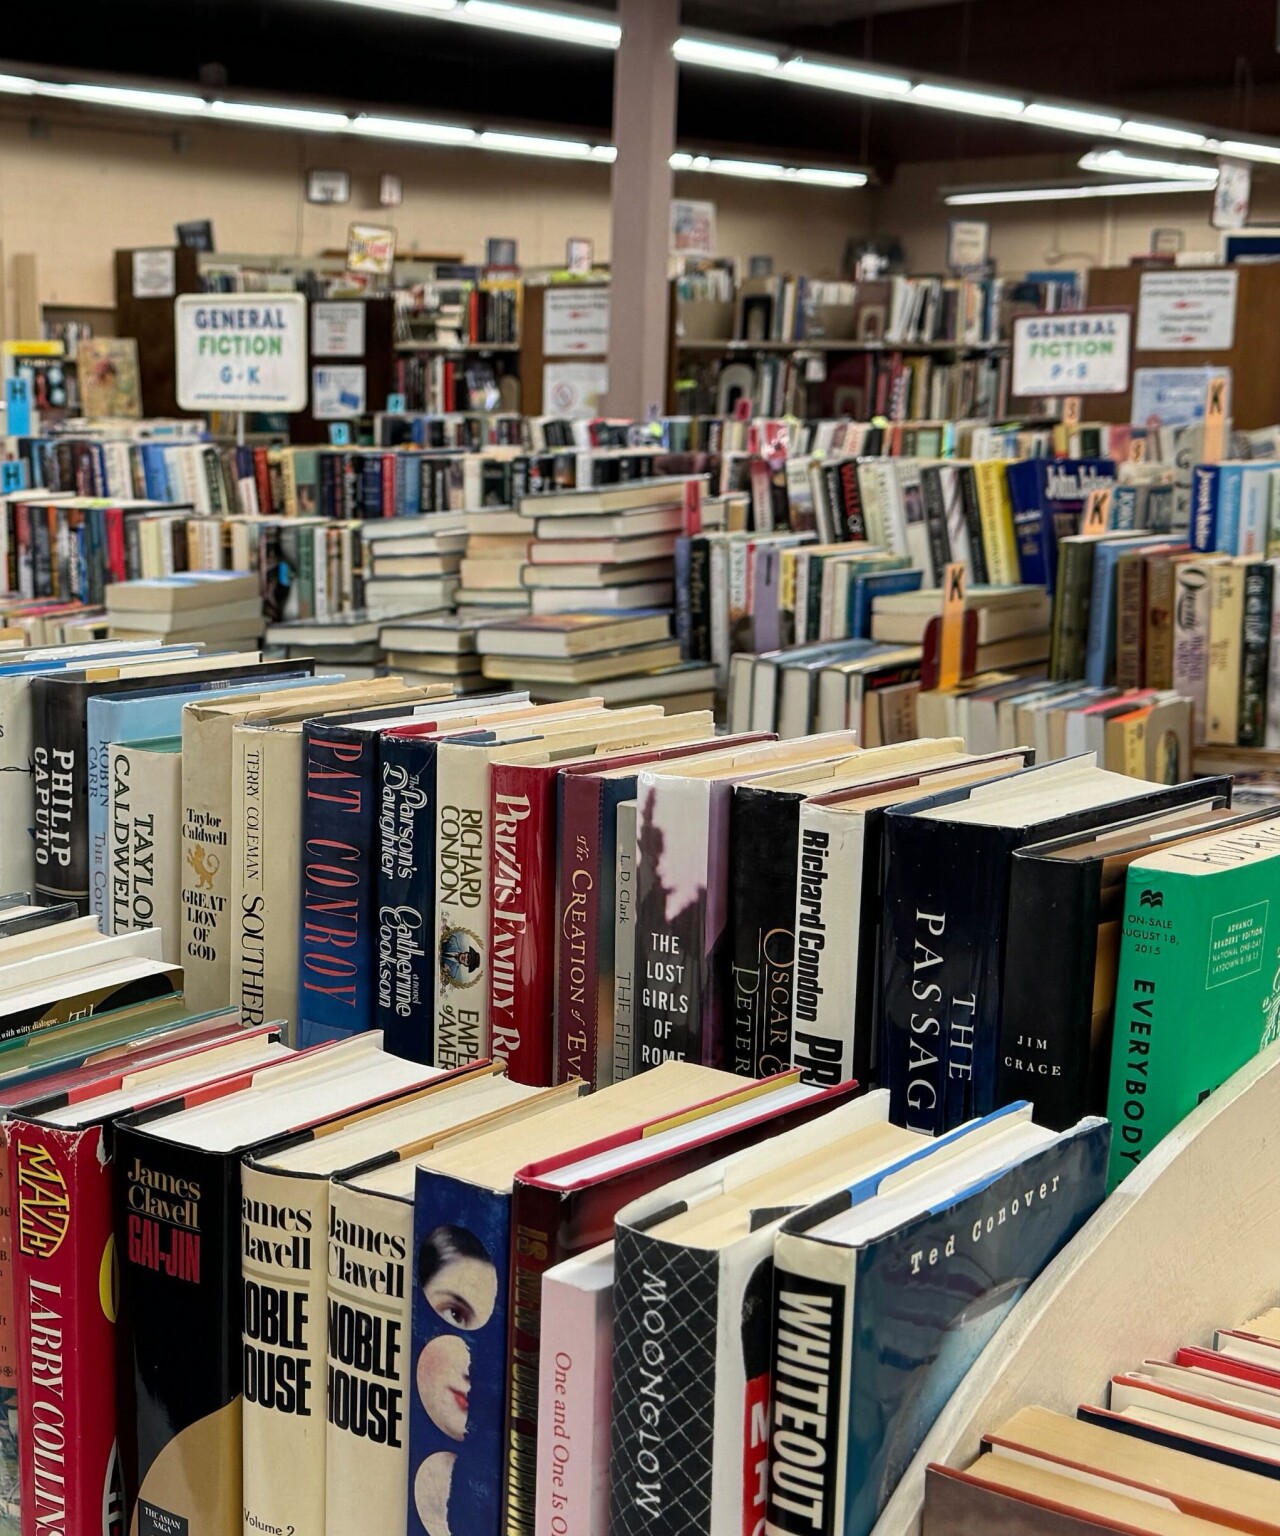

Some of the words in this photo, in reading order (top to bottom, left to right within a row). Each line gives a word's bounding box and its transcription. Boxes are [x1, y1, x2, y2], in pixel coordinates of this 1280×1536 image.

[195, 308, 286, 330] GENERAL
[1027, 320, 1116, 338] GENERAL
[198, 335, 282, 356] FICTION
[1029, 341, 1114, 358] FICTION
[220, 367, 233, 384] G
[247, 367, 261, 384] K
[1209, 380, 1226, 415] K
[4, 463, 21, 488] H
[1089, 492, 1110, 526] K
[949, 566, 965, 603] K
[89, 746, 99, 798] CARR
[98, 740, 110, 807] ROBYN
[246, 750, 260, 801] TERRY
[306, 737, 363, 813] PAT
[34, 746, 50, 865] CAPUTO
[51, 747, 75, 868] PHILIP
[186, 807, 222, 828] Taylor
[378, 761, 408, 880] Daughter
[113, 753, 132, 935] CALDWELL
[182, 823, 228, 846] Caldwell
[246, 806, 260, 881] COLEMAN
[440, 804, 461, 906] CONDON
[460, 808, 484, 908] RICHARD
[182, 889, 227, 912] GREAT
[798, 828, 830, 930] Richard
[187, 908, 218, 928] LION
[193, 925, 211, 943] OF
[303, 837, 361, 1009] CONROY
[650, 932, 680, 955] THE
[1121, 928, 1159, 942] AUGUST
[1127, 914, 1174, 930] ON-SALE
[187, 941, 217, 963] GOD
[240, 893, 266, 1027] SOUTHER
[378, 904, 396, 1008] Cookson
[395, 904, 425, 1018] Catherine
[646, 960, 685, 985] LOST
[1134, 943, 1162, 956] 2015
[642, 988, 689, 1015] GIRLS
[795, 930, 826, 1022] Condon
[653, 1018, 673, 1041] OF
[731, 960, 761, 1075] PETER
[948, 993, 976, 1081] THE
[1016, 1034, 1048, 1051] JIM
[1004, 1055, 1062, 1077] CRACE
[1119, 978, 1156, 1164] EVERYBODY
[16, 1138, 71, 1260] MAZE
[126, 1158, 202, 1201] James
[126, 1184, 202, 1228] Clavell
[327, 1203, 407, 1260] James
[910, 1234, 956, 1275] Ted
[972, 1174, 1061, 1243] Conover
[127, 1214, 202, 1285] GAI-JIN
[327, 1240, 406, 1299] Clavell
[28, 1275, 65, 1401] LARRY
[327, 1297, 403, 1381] NOBLE
[554, 1351, 573, 1395] One
[635, 1268, 668, 1521] MOONGLOW
[327, 1368, 404, 1450] HOUSE
[553, 1399, 571, 1441] and
[770, 1289, 834, 1531] WHITEOUT
[30, 1401, 68, 1536] COLLINS
[551, 1443, 570, 1487] One
